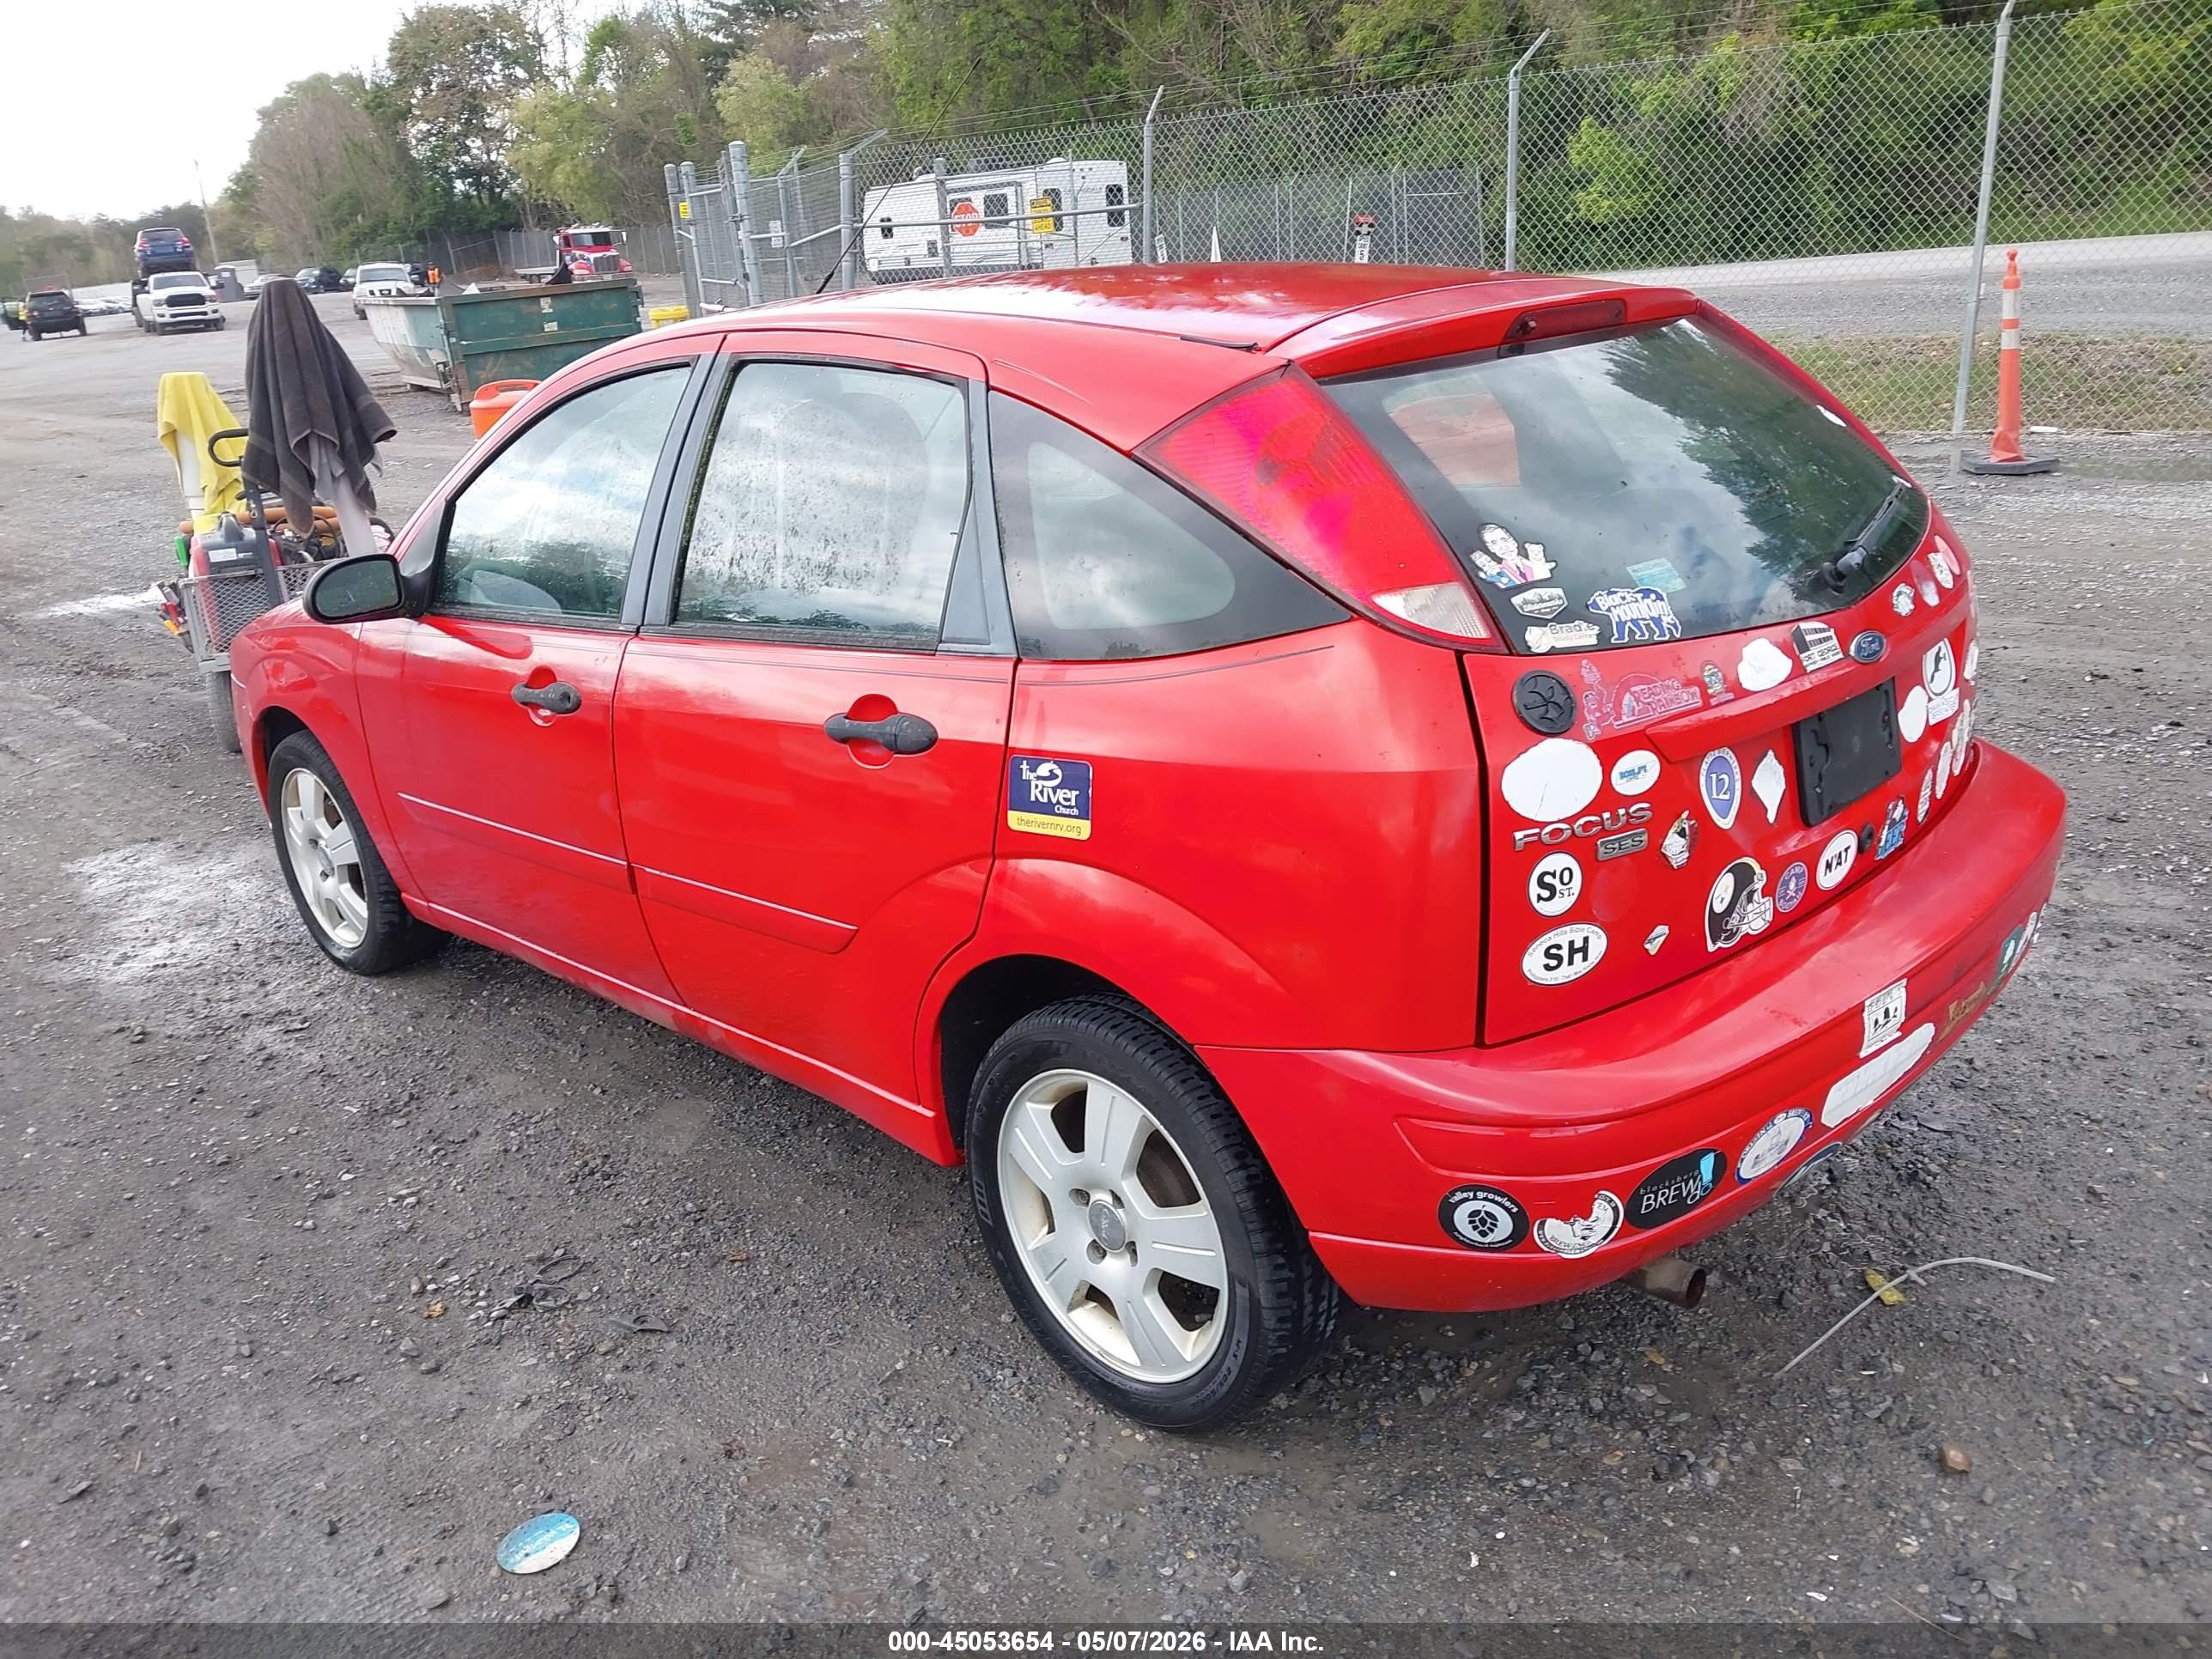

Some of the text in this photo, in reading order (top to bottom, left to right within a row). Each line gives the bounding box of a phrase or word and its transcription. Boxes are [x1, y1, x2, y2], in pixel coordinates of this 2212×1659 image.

[1020, 760, 1037, 780] the
[1030, 780, 1079, 806] River
[1709, 773, 1730, 800] 12
[1054, 805, 1079, 816] Church
[1017, 816, 1082, 836] therivernrv.org
[1513, 802, 1652, 851] FOCUS
[1603, 834, 1644, 854] SES
[1824, 845, 1850, 876] N'AT
[1542, 935, 1589, 971] SH
[1448, 1191, 1519, 1213] valley growlers
